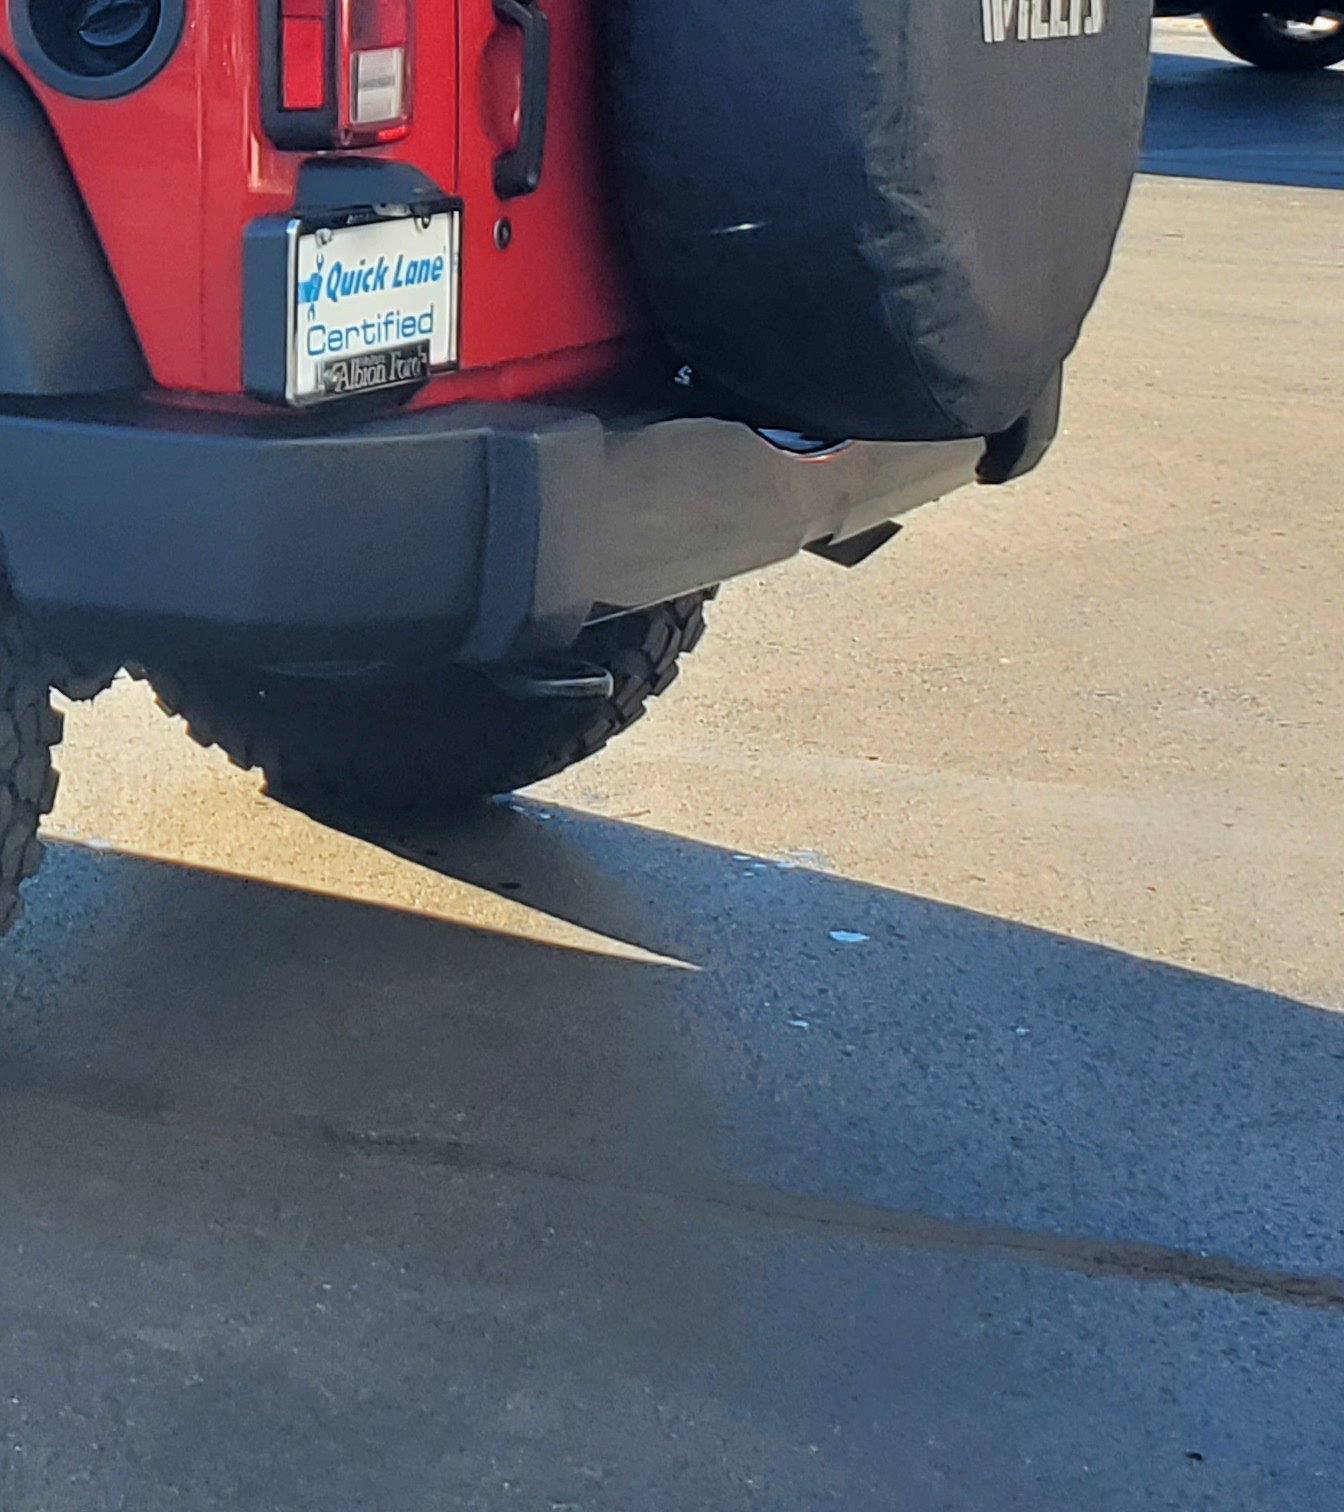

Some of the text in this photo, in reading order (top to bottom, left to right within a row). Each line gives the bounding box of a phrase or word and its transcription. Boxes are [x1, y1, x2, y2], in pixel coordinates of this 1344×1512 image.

[326, 253, 444, 303] Quick Lane
[306, 303, 434, 356] Certified
[331, 356, 387, 393] Albion
